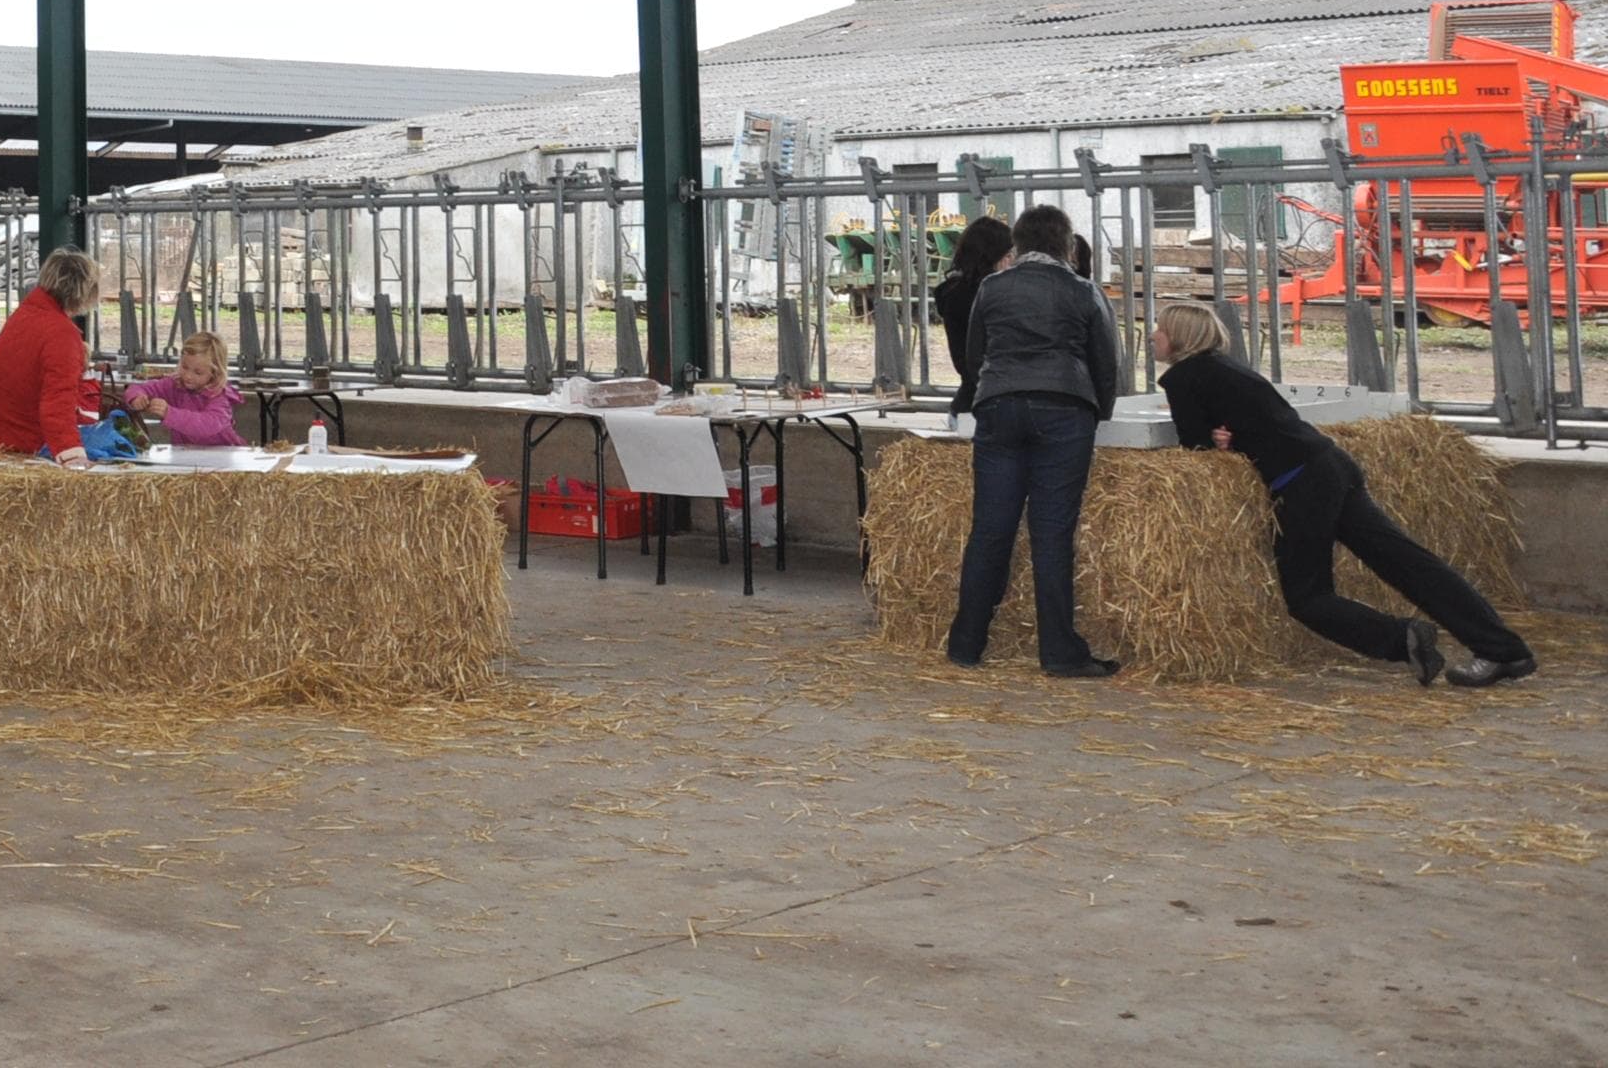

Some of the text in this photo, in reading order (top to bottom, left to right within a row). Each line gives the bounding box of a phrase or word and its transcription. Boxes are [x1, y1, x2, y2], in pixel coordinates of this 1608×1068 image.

[1355, 78, 1511, 97] GOOSSENS TIELT
[1317, 386, 1325, 397] 2
[1344, 386, 1352, 398] 6
